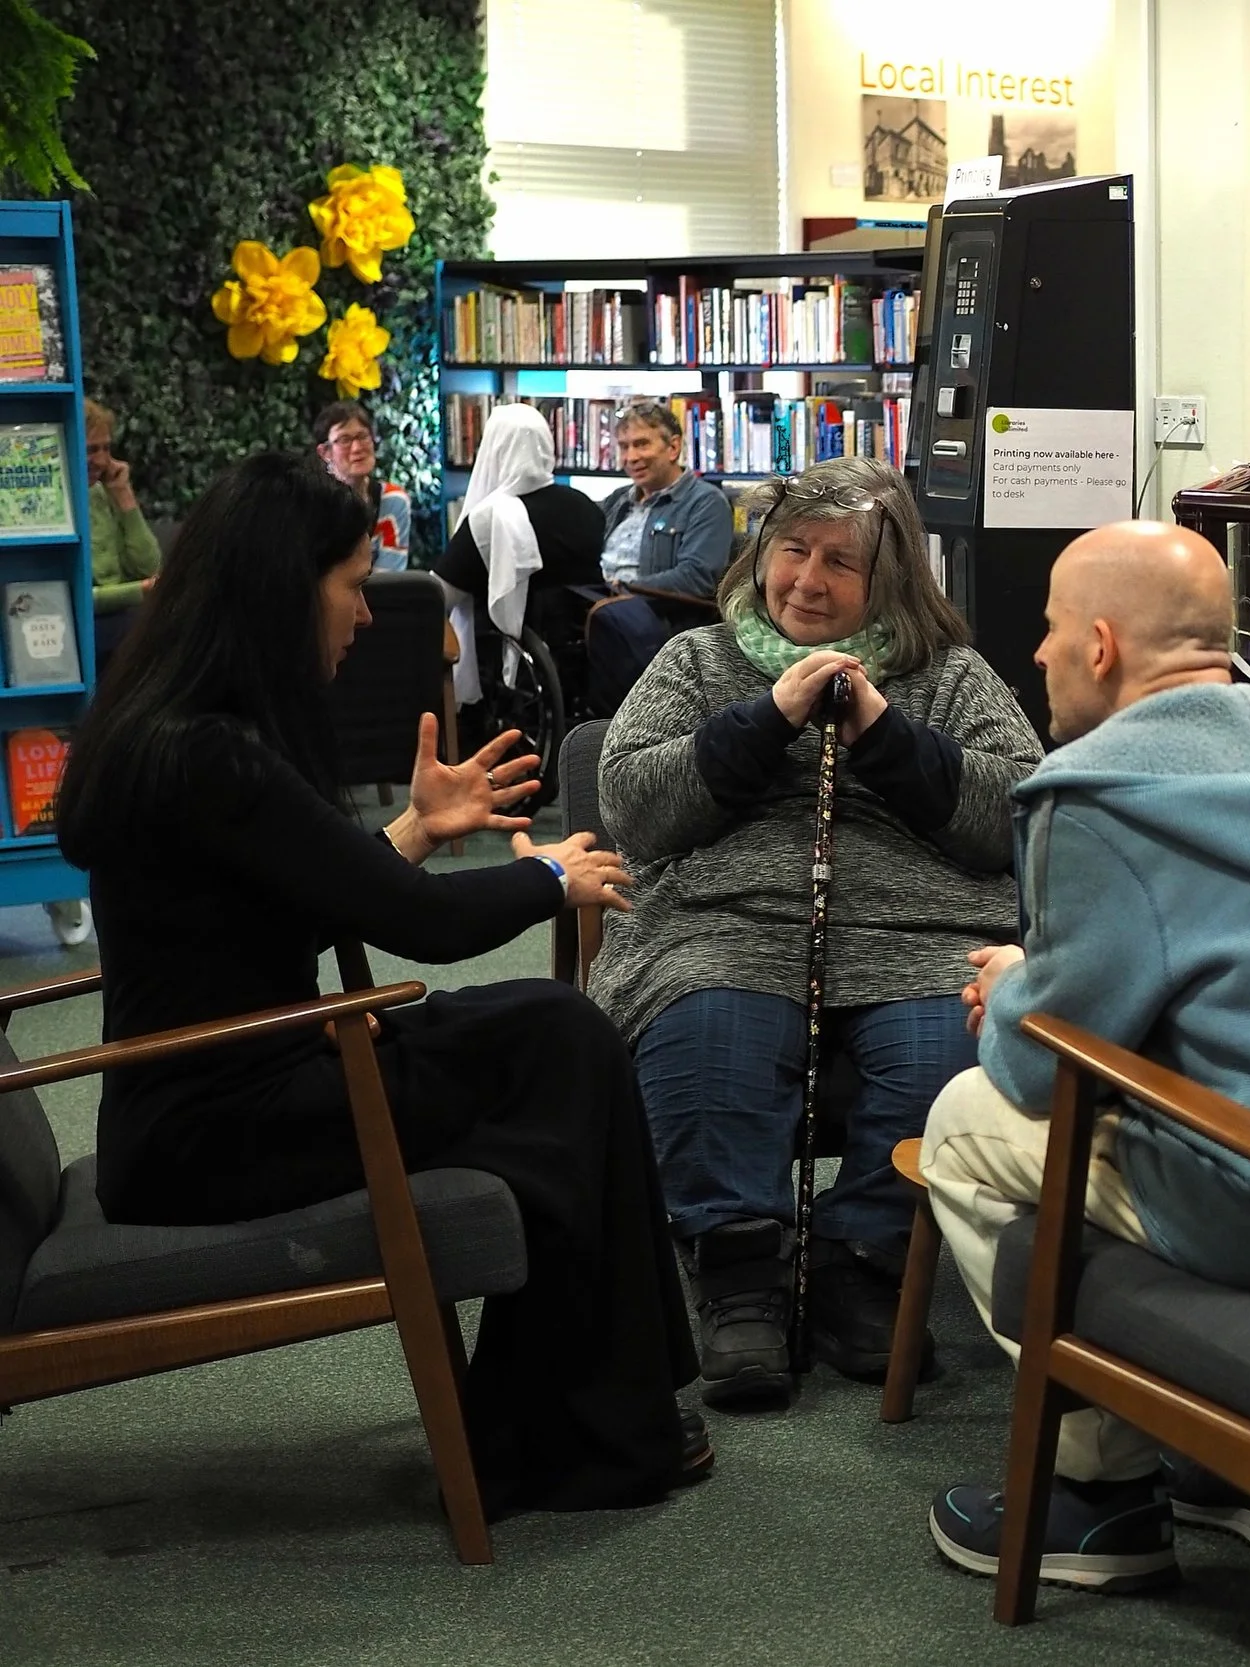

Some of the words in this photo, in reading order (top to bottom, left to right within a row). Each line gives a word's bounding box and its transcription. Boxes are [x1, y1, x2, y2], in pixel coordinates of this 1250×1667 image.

[860, 52, 944, 95] Local
[957, 62, 1074, 106] Interest
[993, 448, 1031, 459] Printing
[1055, 450, 1093, 459] available
[1095, 451, 1114, 459] here
[993, 463, 1015, 471] Card
[1016, 464, 1061, 474] payments
[1063, 464, 1081, 474] only
[993, 476, 1008, 484] For
[1010, 476, 1031, 485] cash
[1034, 478, 1078, 488] payments
[1086, 477, 1113, 487] Please
[1115, 479, 1127, 488] go
[992, 490, 1001, 498] to
[1003, 490, 1025, 498] desk
[25, 760, 61, 778] LIF
